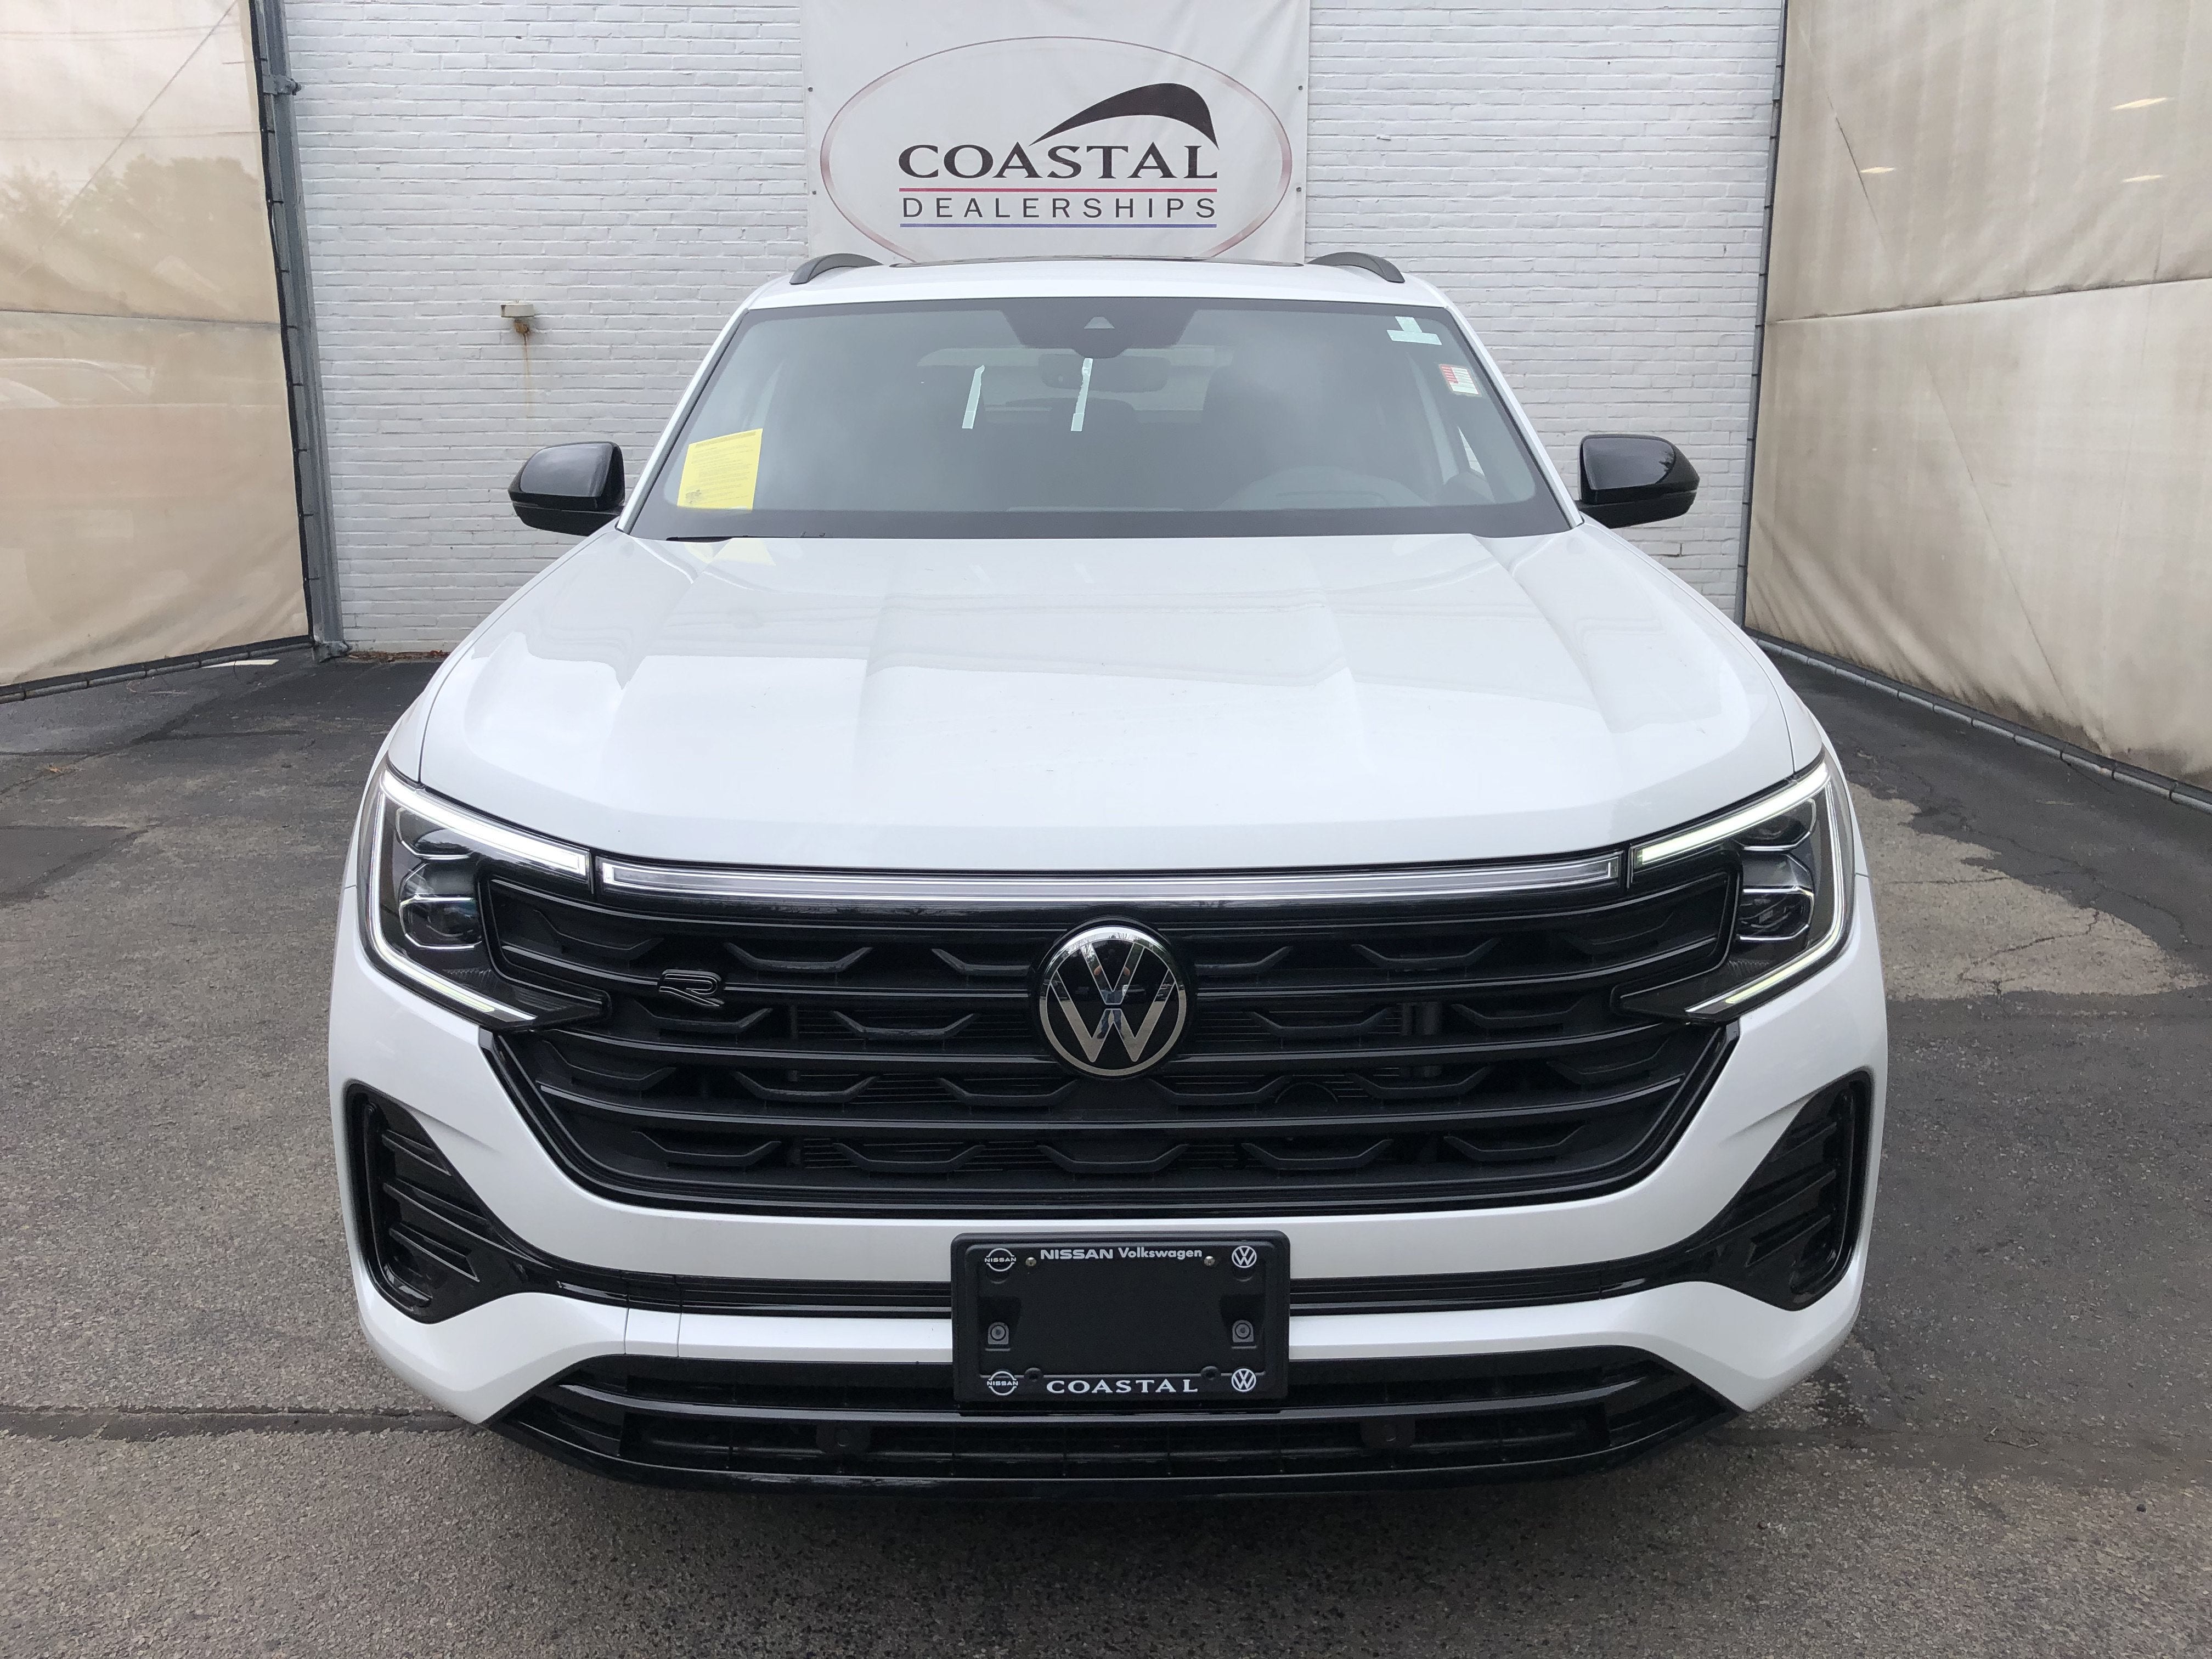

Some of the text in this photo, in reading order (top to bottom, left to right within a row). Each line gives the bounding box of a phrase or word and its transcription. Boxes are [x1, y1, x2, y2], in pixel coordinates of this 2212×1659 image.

[898, 142, 1218, 179] COASTAL
[902, 197, 1215, 218] DEALERSHIPS
[1040, 1246, 1203, 1260] NISSAN Volkswagen
[1046, 1378, 1198, 1394] COASTAL
